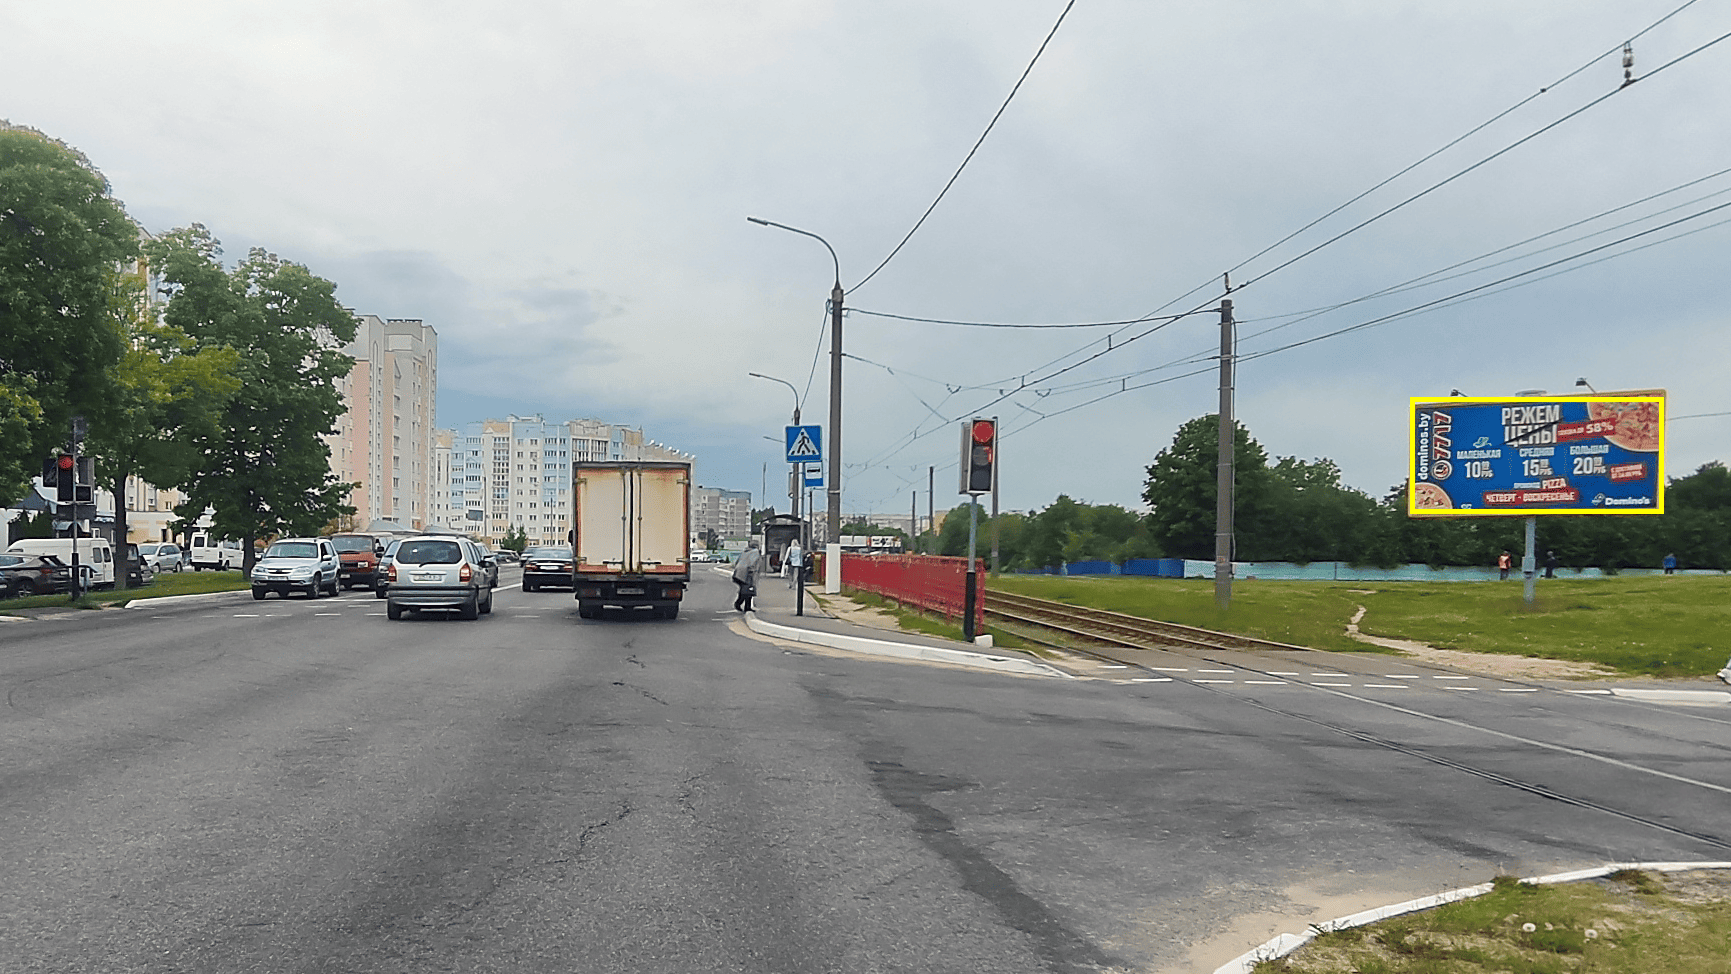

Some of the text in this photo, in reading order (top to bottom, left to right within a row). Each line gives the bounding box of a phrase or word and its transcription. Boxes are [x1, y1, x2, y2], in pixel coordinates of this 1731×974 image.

[1501, 405, 1560, 425] РЕЖЕМ
[1432, 410, 1452, 461] 7717
[1504, 424, 1558, 448] ЦЕНЫ
[1586, 421, 1614, 434] 58%
[1417, 413, 1431, 481] dominos.by
